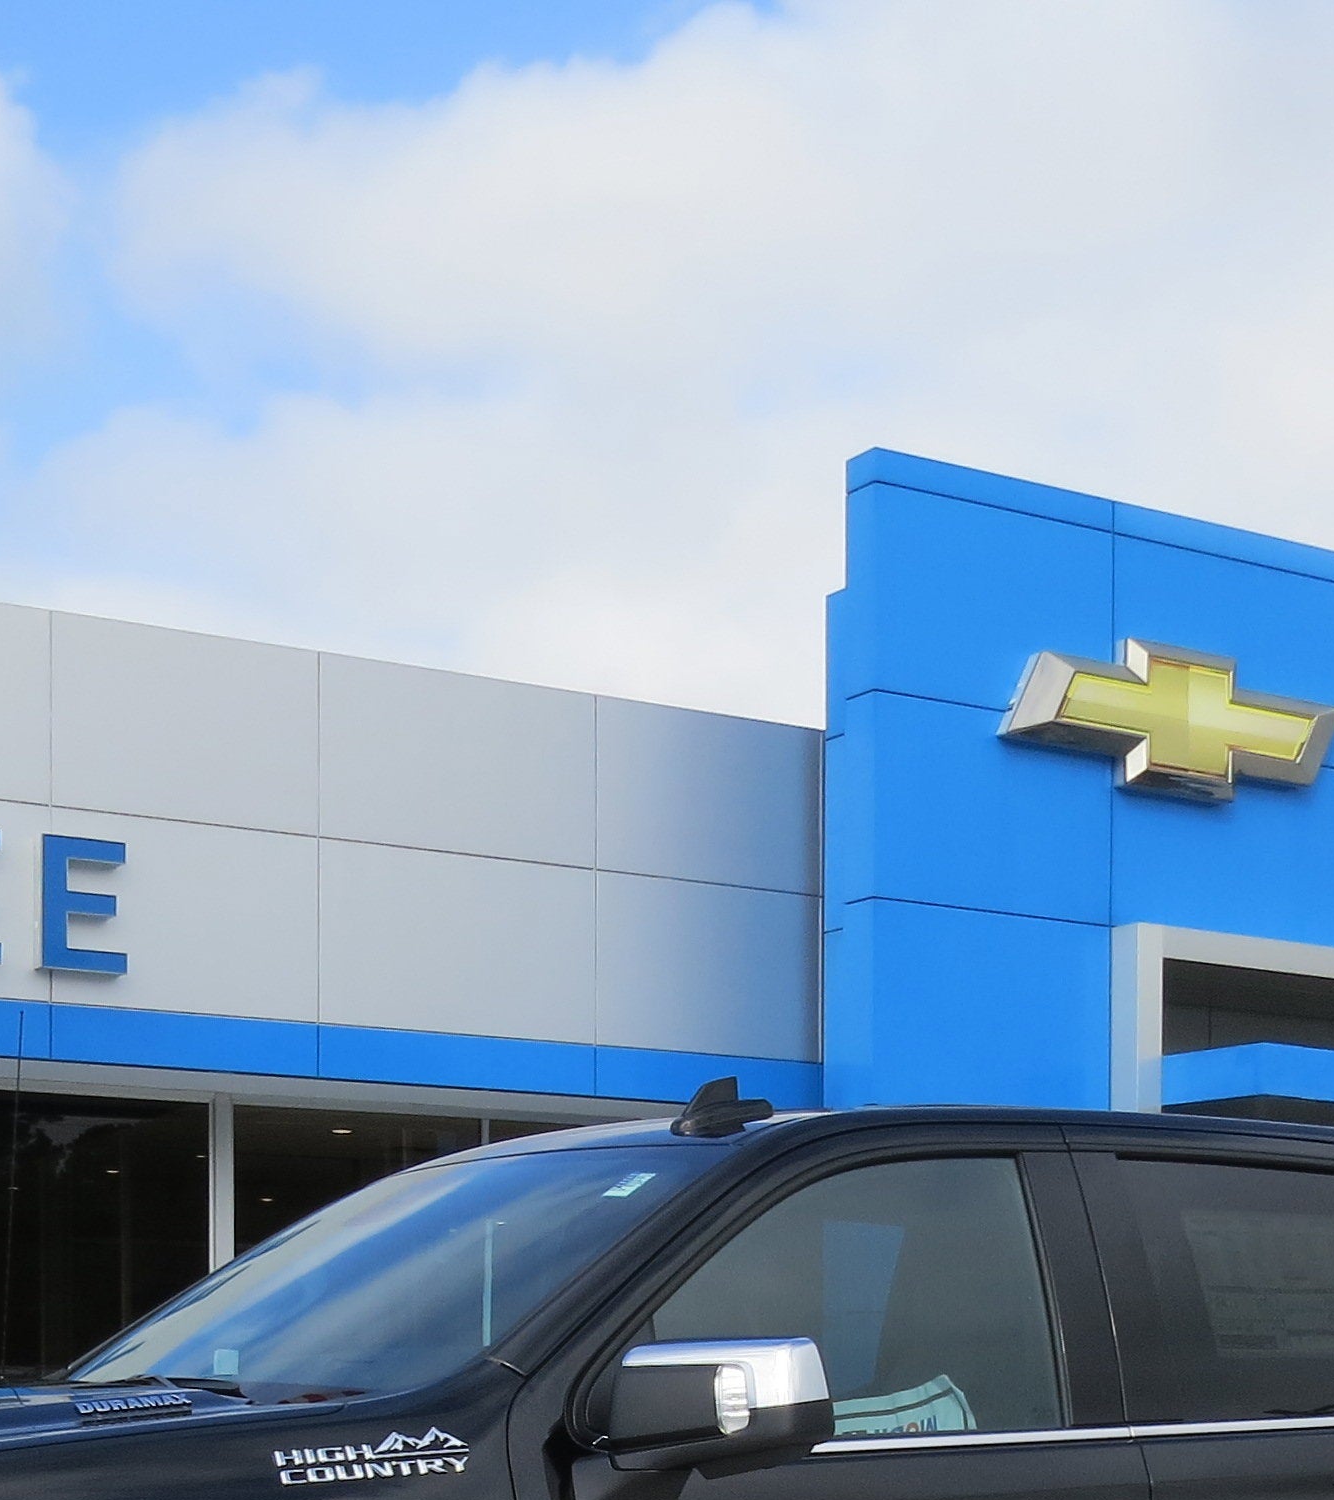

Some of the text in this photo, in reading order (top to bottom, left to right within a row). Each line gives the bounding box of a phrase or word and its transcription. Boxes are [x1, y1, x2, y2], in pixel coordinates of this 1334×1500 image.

[75, 1393, 192, 1414] DURAMAX
[273, 1443, 377, 1467] HIGH
[280, 1456, 469, 1486] COUNTRY
